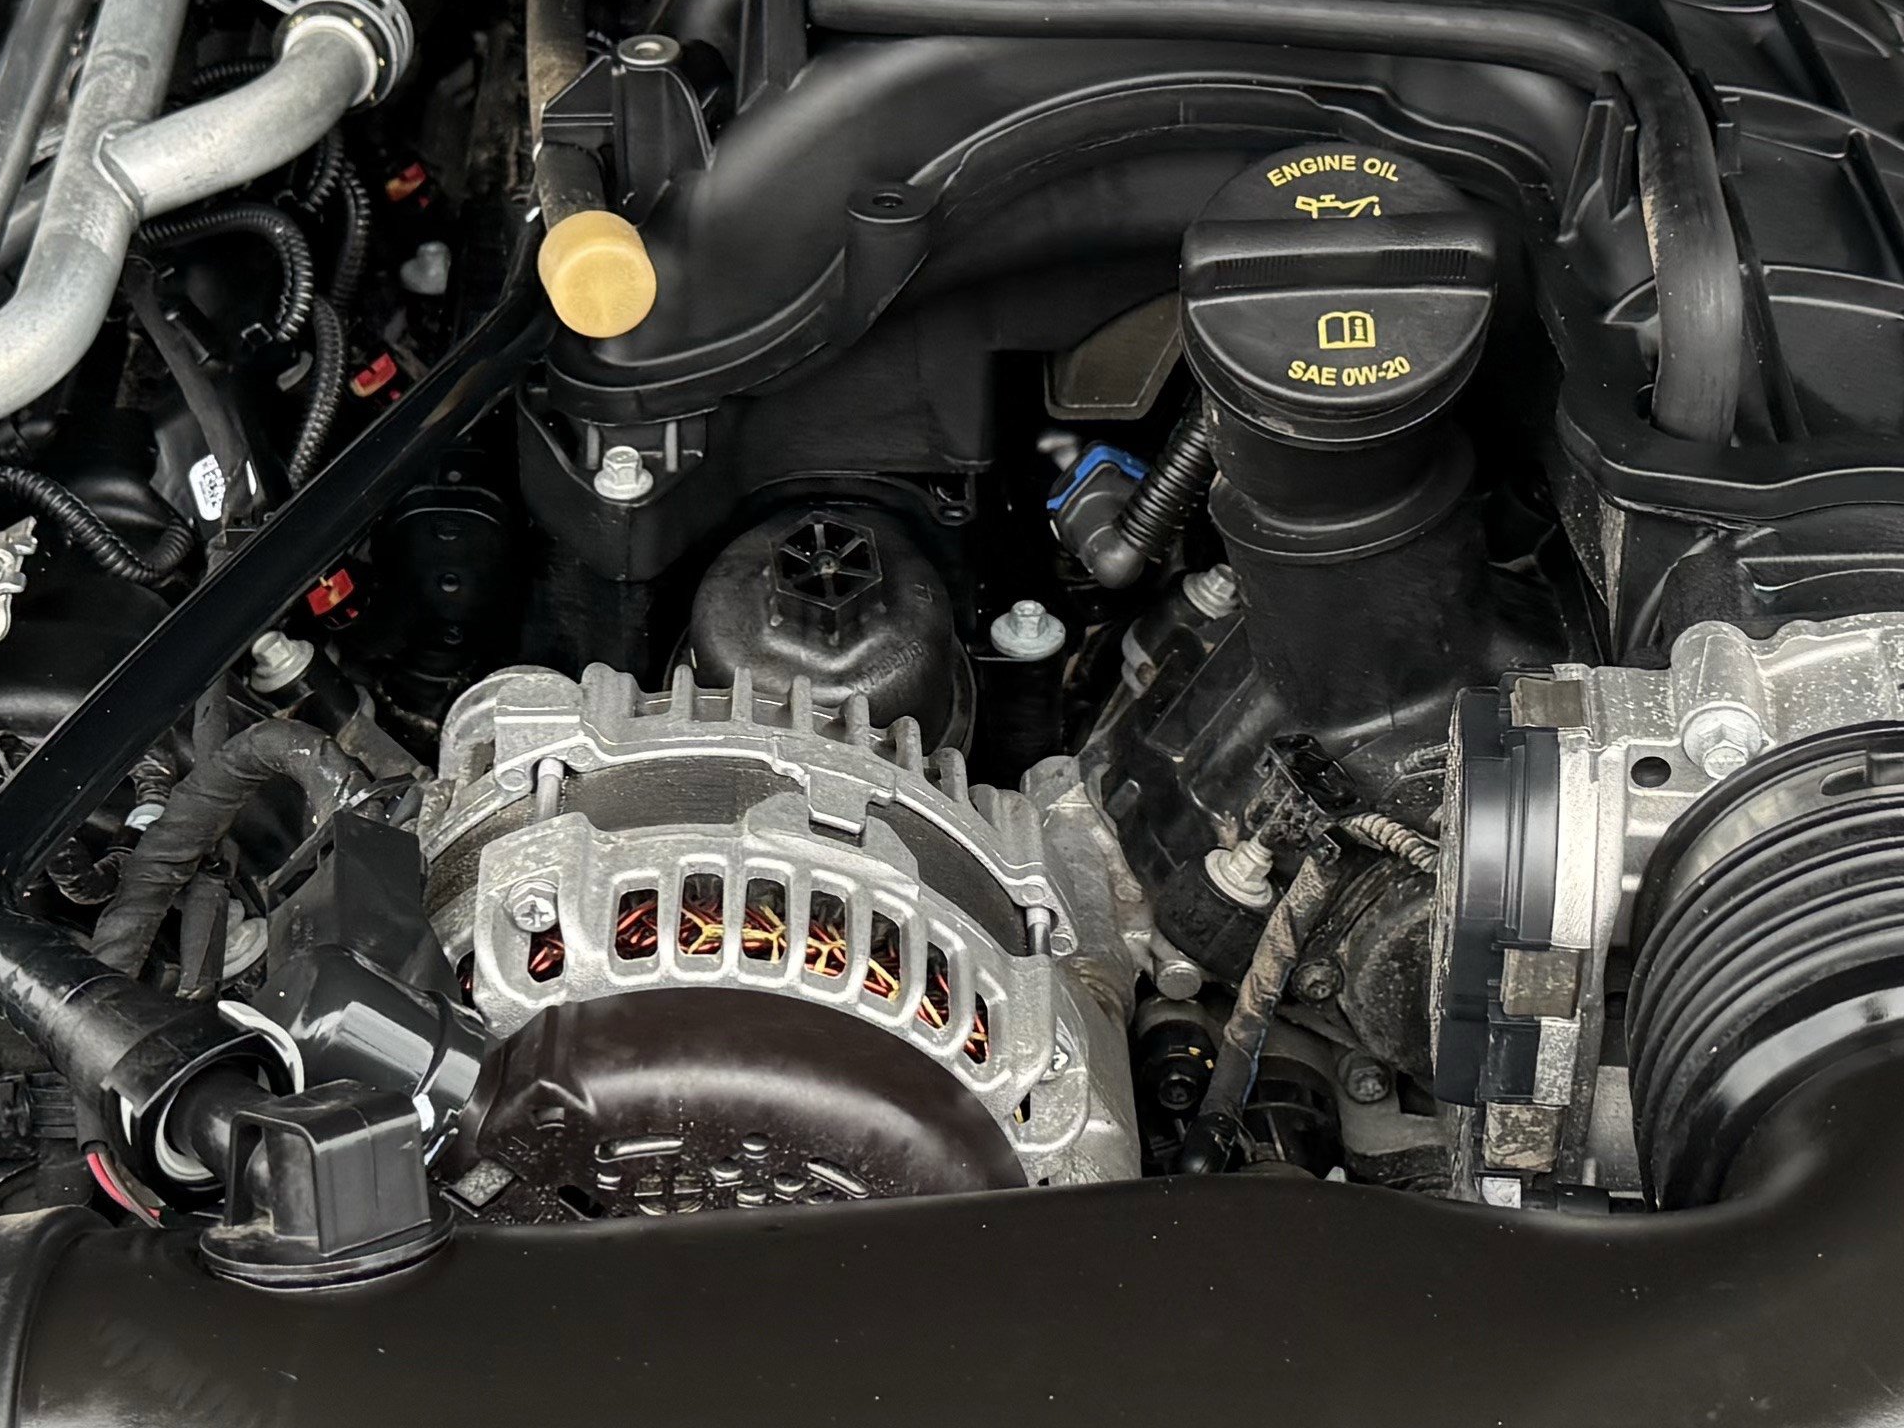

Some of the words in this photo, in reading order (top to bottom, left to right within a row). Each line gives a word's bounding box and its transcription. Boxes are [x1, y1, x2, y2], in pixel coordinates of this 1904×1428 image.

[1267, 154, 1357, 187] ENGINE
[1362, 157, 1399, 182] OIL
[1288, 360, 1337, 387] SAE
[1342, 356, 1411, 387] 0W-20
